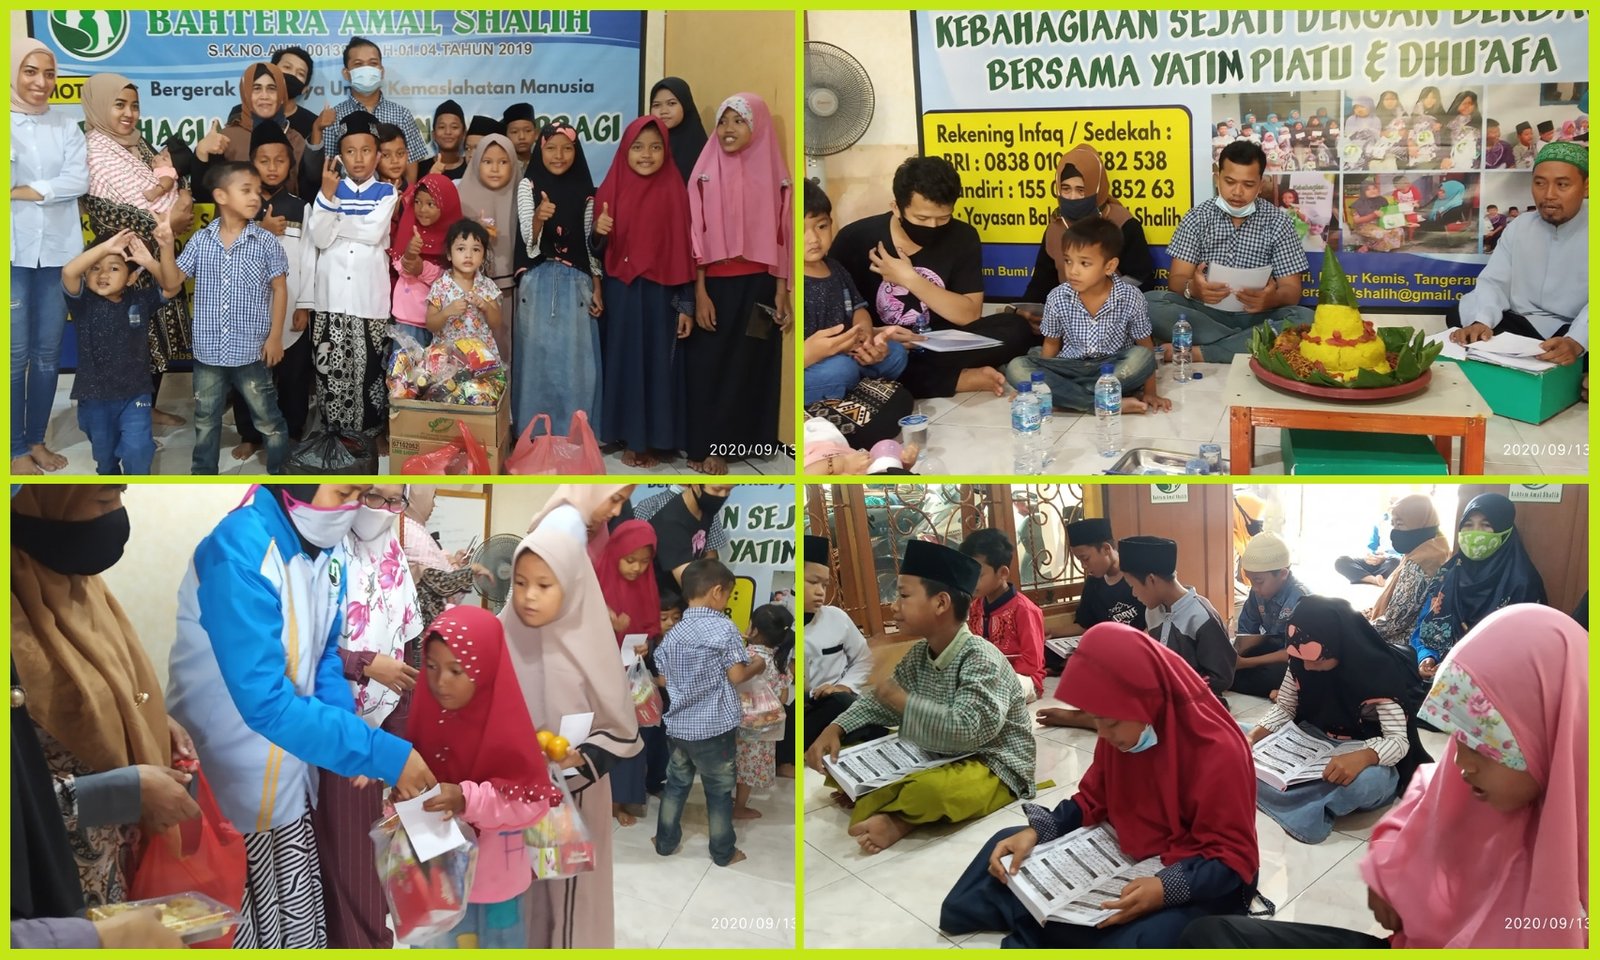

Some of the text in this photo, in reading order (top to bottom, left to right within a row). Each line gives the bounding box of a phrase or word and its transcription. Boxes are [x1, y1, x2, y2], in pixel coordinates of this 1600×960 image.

[147, 10, 591, 36] BAHTERA AMAL SHALIH
[936, 10, 1158, 48] KEBAHAGIAAN
[1169, 10, 1283, 37] SEJATI
[499, 43, 532, 56] 2019
[986, 36, 1558, 91] BERSAMA YATIM PIATU & DHU'AFA
[151, 78, 595, 101] Bergerak Kemaslahatan Manusia
[937, 124, 1014, 148] Rekening
[1019, 122, 1064, 147] Infaq
[1069, 121, 1078, 144] /
[1084, 120, 1161, 142] Sedekah
[985, 152, 1029, 171] 0838
[1133, 151, 1167, 171] 538
[1018, 180, 1046, 199] 155
[1151, 178, 1175, 198] 63
[964, 206, 1025, 231] Yayasan
[1135, 206, 1182, 227] Shalih
[998, 266, 1028, 277] Bumi
[1361, 273, 1410, 286] Kemis,
